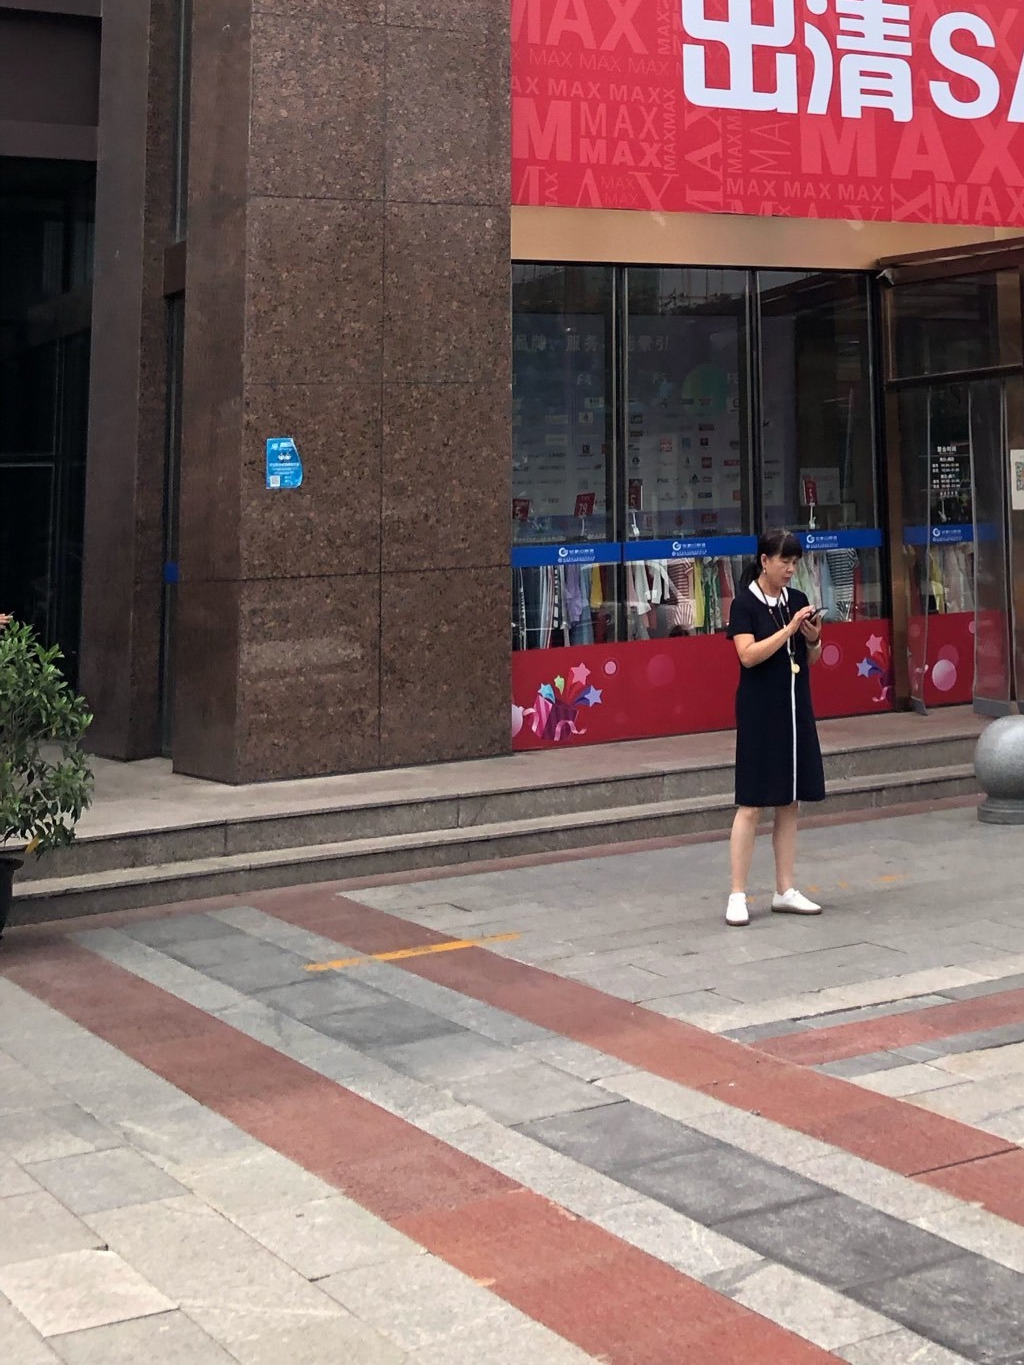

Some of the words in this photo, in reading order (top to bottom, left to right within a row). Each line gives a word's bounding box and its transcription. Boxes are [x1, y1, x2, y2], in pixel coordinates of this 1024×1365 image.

[530, 48, 573, 68] MAX
[580, 52, 623, 72] MAX
[628, 57, 670, 76] MAX
[548, 79, 600, 98] MAX
[609, 84, 664, 103] MAX
[580, 101, 660, 140] MAX
[580, 138, 663, 168] MAX
[727, 178, 777, 197] MAX
[784, 180, 832, 200] MAX
[838, 184, 885, 202] MAX
